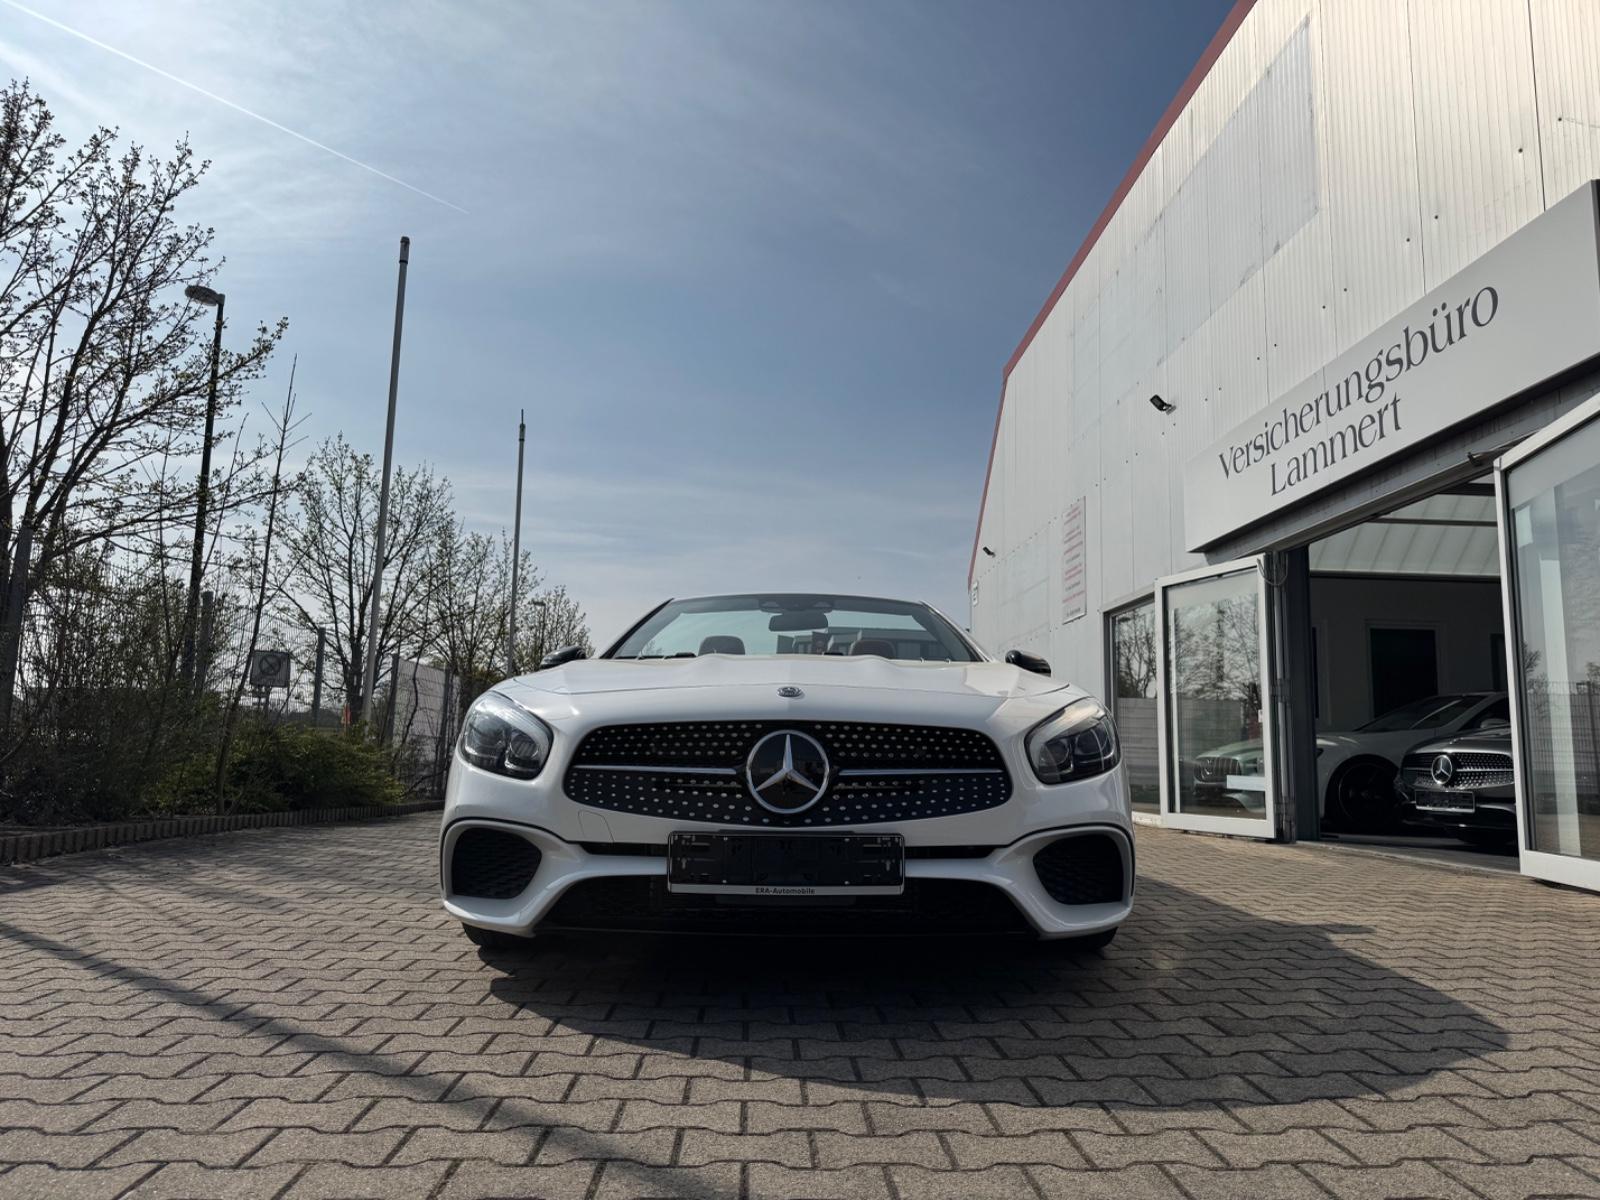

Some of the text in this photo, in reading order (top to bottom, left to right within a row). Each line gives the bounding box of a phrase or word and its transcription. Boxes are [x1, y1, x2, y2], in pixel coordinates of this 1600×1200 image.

[1219, 286, 1499, 479] Versicherungsbüro
[1270, 392, 1402, 496] Lammert
[755, 887, 816, 895] ERA-Automobile
